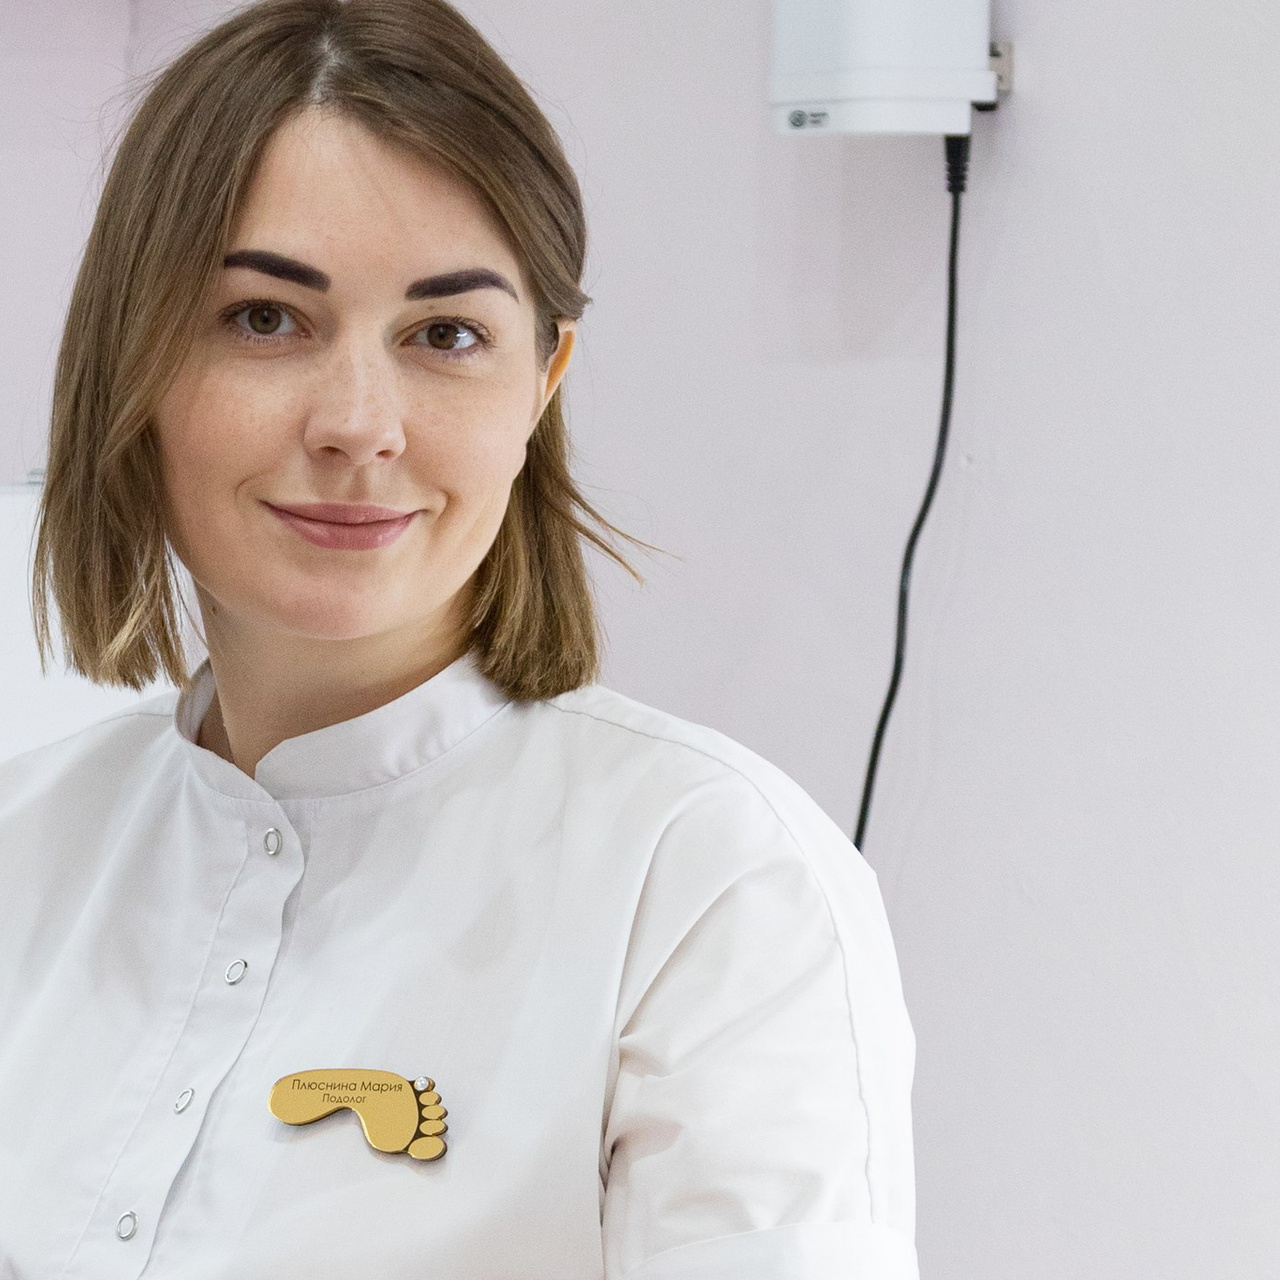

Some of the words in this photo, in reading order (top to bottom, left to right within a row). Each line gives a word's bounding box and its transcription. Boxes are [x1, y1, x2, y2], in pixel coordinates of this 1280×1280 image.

[291, 1078, 357, 1091] Плюснина
[360, 1081, 403, 1094] Мария
[322, 1093, 367, 1104] Подолог
